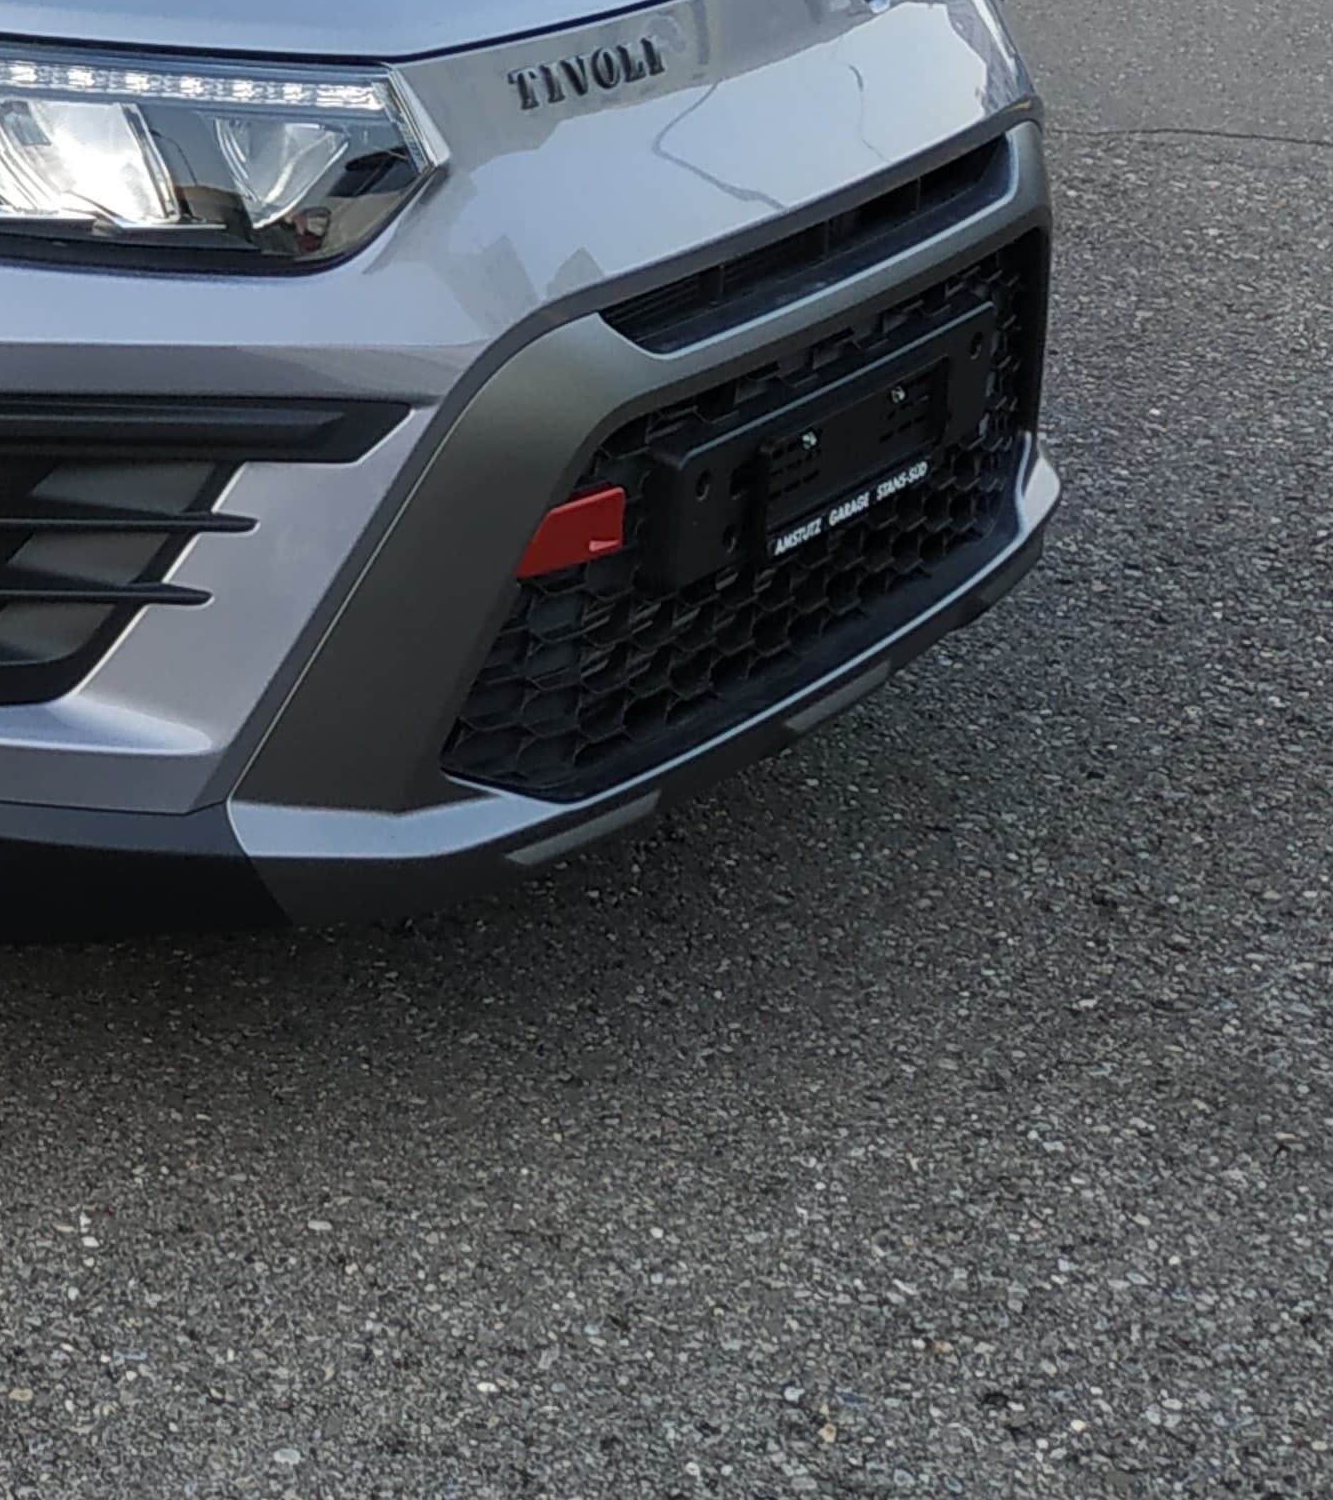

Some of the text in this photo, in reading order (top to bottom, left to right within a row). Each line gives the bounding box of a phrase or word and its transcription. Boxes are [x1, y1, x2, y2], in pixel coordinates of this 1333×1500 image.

[507, 36, 666, 111] TIVOLI
[774, 517, 823, 556] AMSTUTZ
[828, 491, 871, 527] GARAGE
